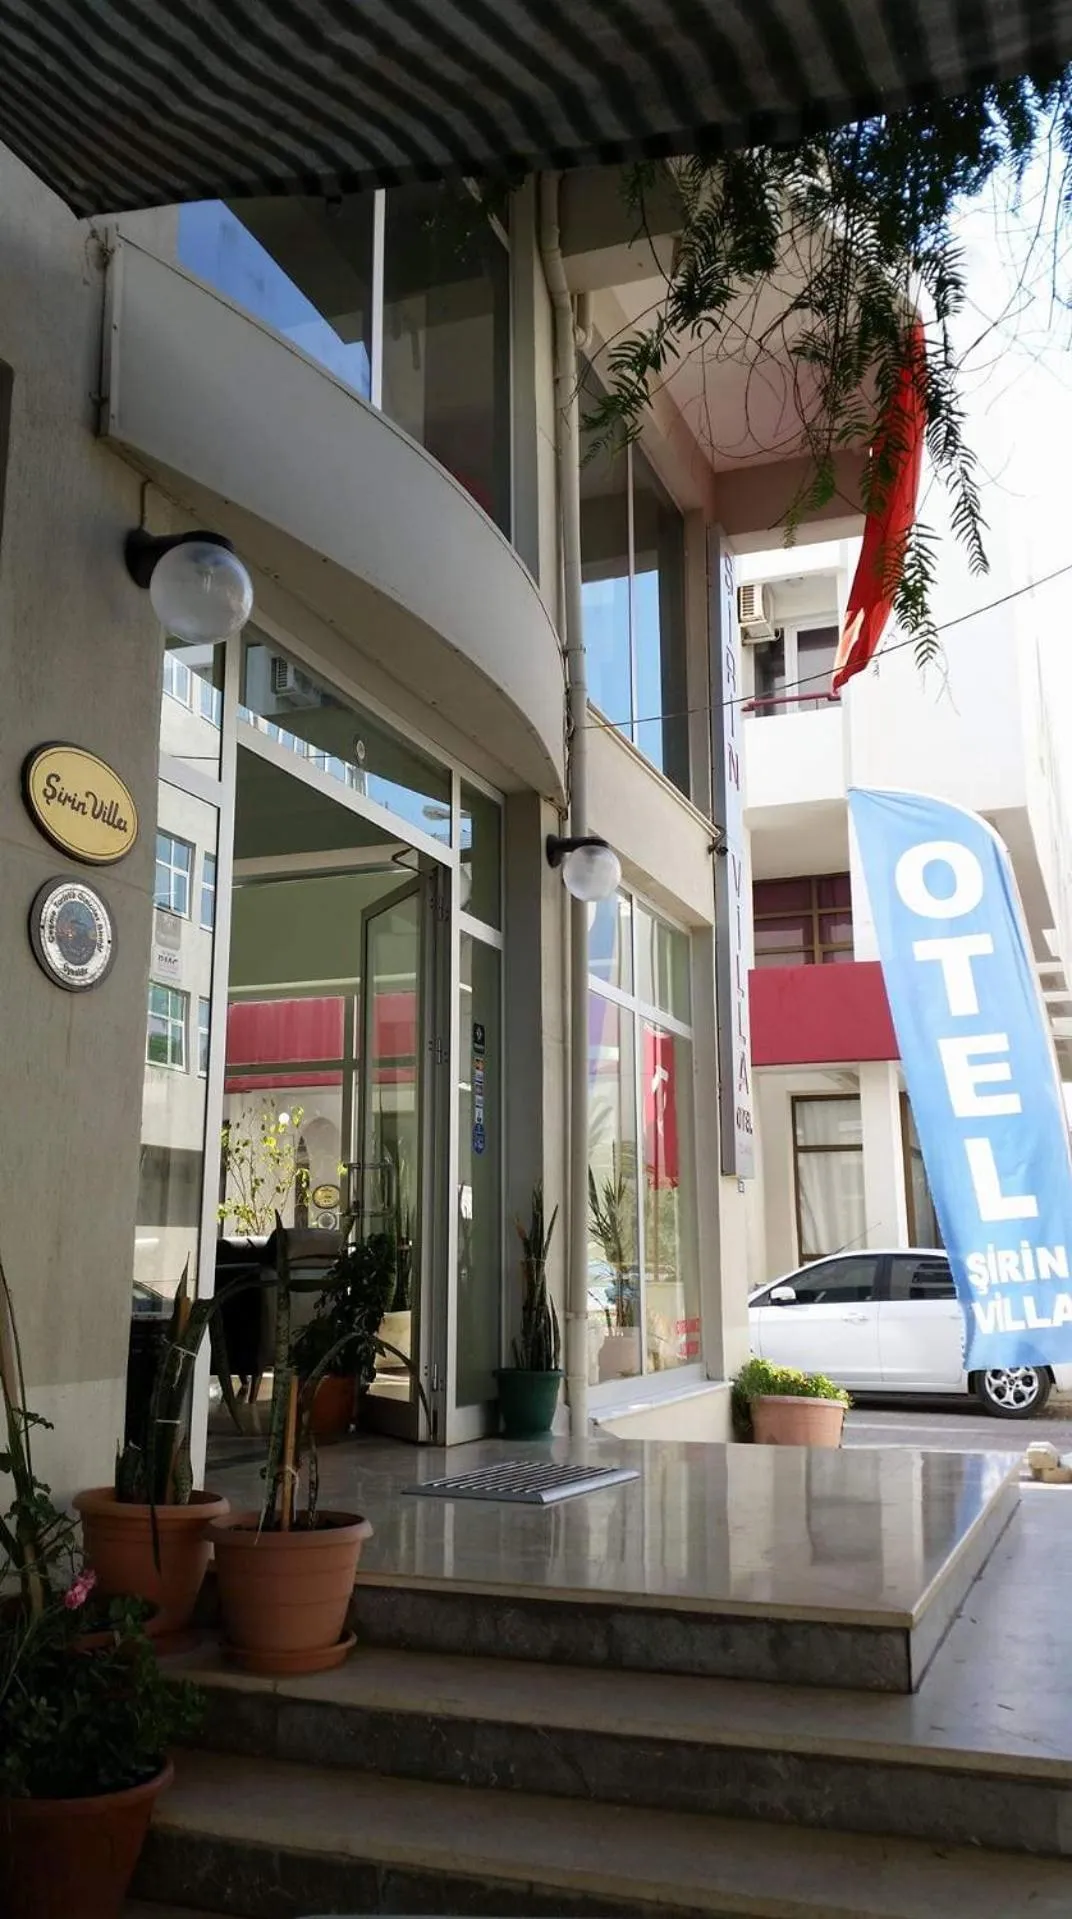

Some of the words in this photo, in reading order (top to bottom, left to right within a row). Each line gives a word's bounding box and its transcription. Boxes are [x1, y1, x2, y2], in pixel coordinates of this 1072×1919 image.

[42, 773, 87, 816] Şirin
[85, 791, 127, 833] Villa
[895, 840, 1038, 1222] OTEL
[966, 1240, 1069, 1296] ŞİRİN
